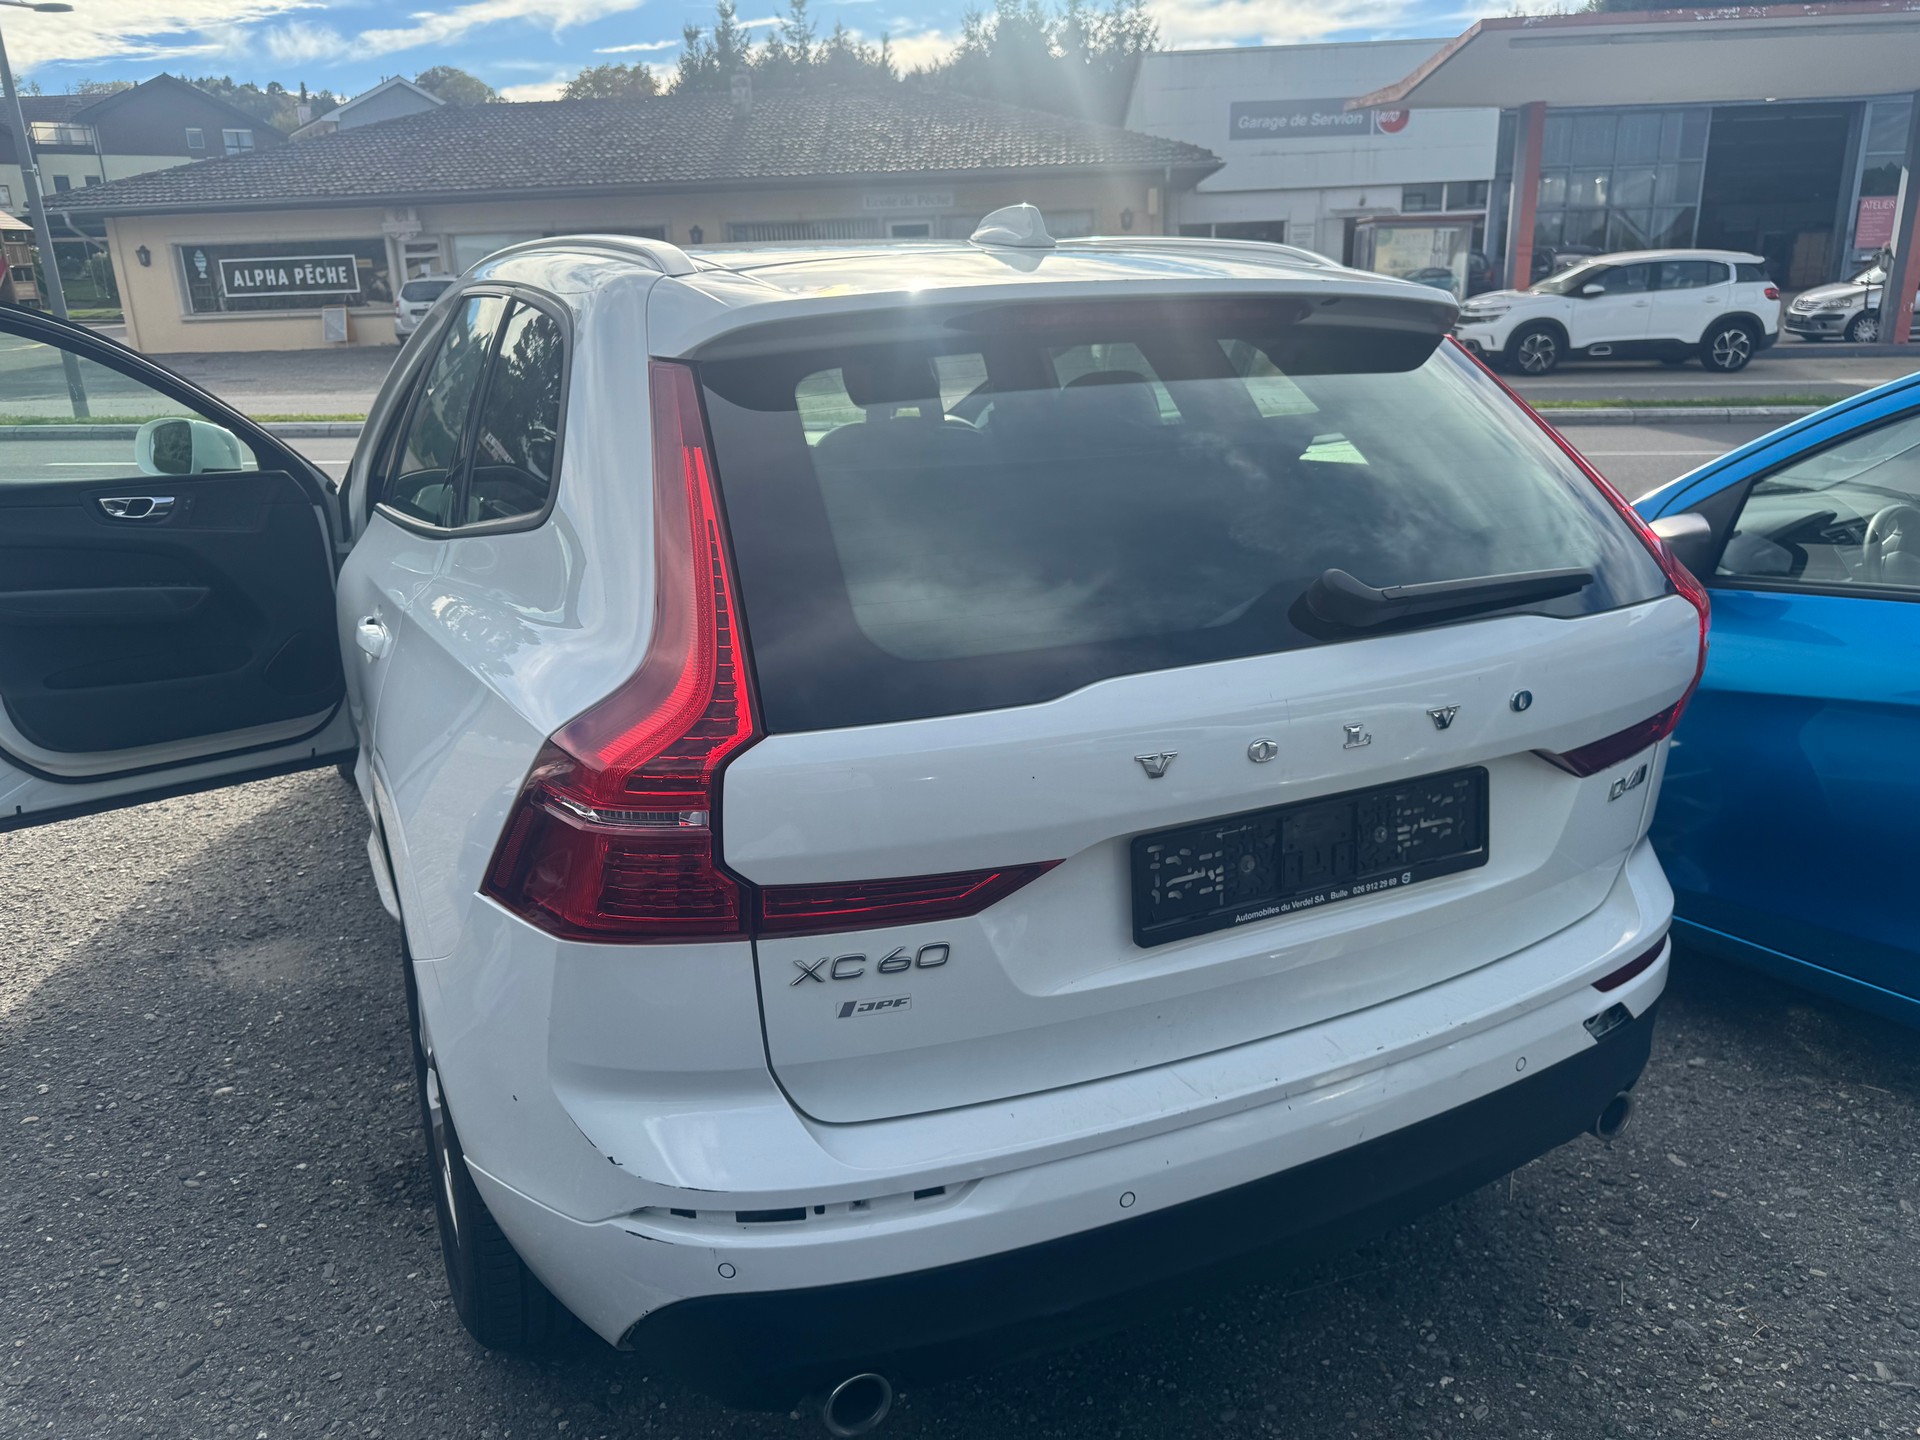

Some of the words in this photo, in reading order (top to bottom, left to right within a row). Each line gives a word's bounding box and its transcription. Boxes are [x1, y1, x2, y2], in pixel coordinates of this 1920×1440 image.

[1238, 115, 1287, 131] Garage
[1290, 114, 1307, 127] de
[1310, 112, 1364, 127] Servion
[1862, 200, 1896, 210] ATELIER
[234, 268, 289, 287] ALPHA
[1134, 688, 1533, 779] VOLVO
[1235, 906, 1280, 923] Automobiles
[1281, 903, 1291, 912] du
[1292, 897, 1314, 910] Verdel
[1314, 894, 1325, 904] SA
[1330, 889, 1349, 900] Bulle
[1353, 885, 1365, 895] 026
[1366, 881, 1379, 892] 912
